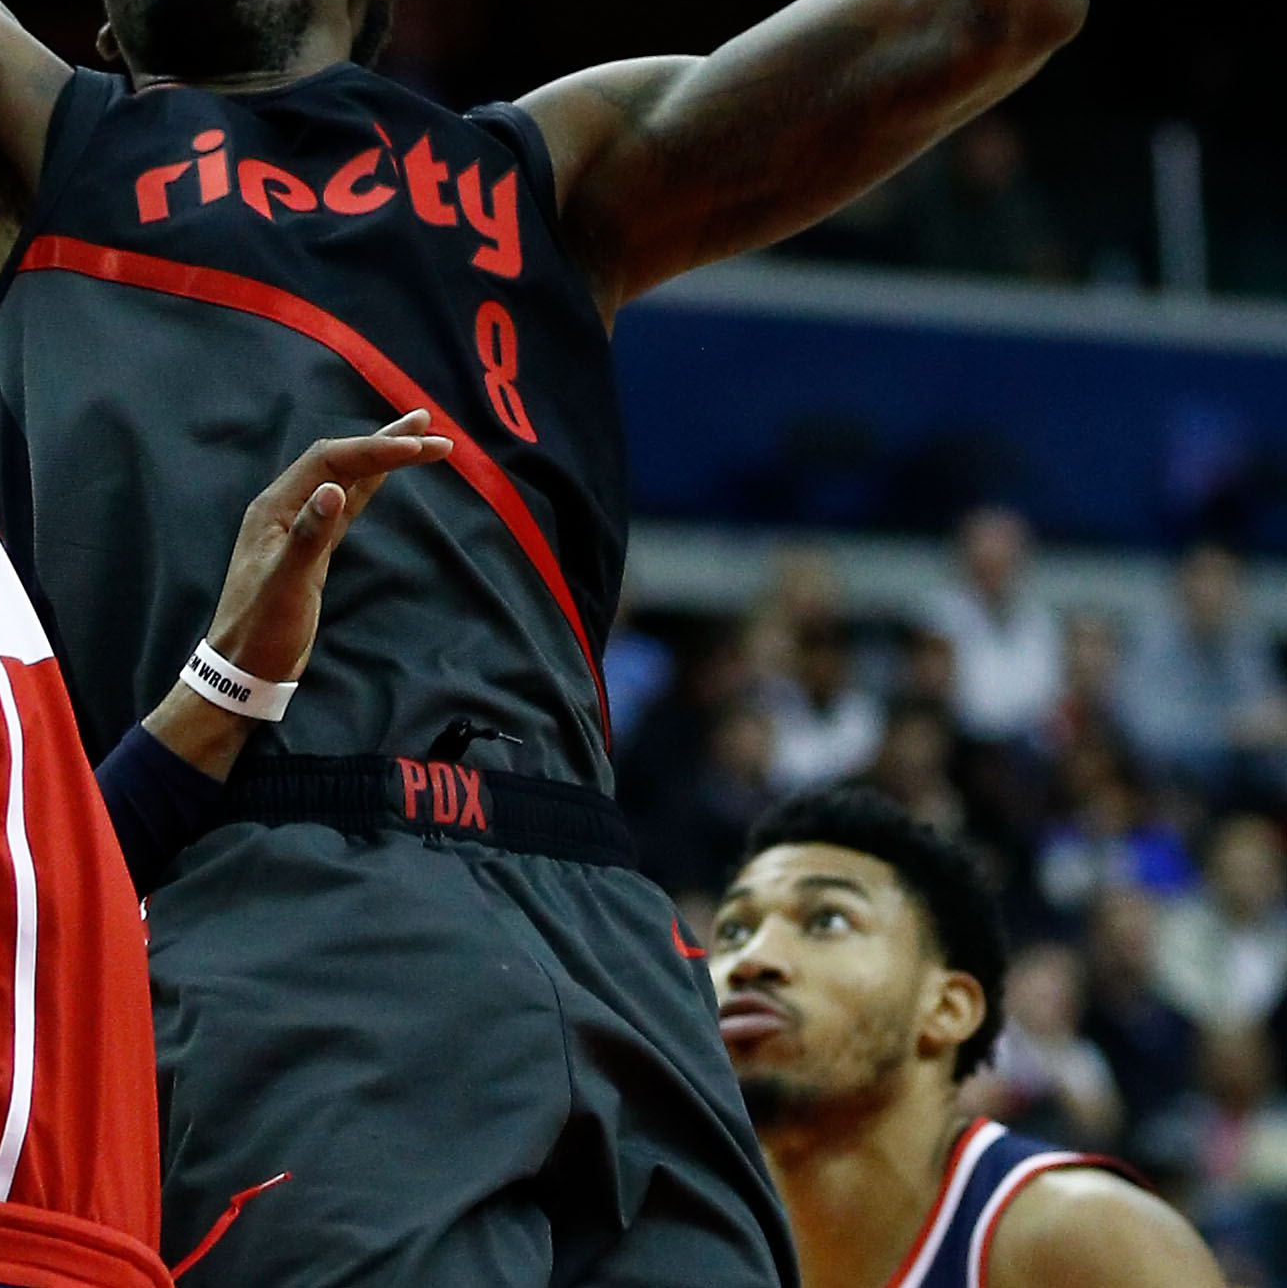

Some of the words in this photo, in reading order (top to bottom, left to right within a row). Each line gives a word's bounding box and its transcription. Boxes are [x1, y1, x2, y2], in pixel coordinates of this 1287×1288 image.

[136, 122, 522, 279] ripcty
[475, 299, 538, 443] 8
[198, 662, 252, 702] WRONG
[396, 756, 486, 831] PDX
